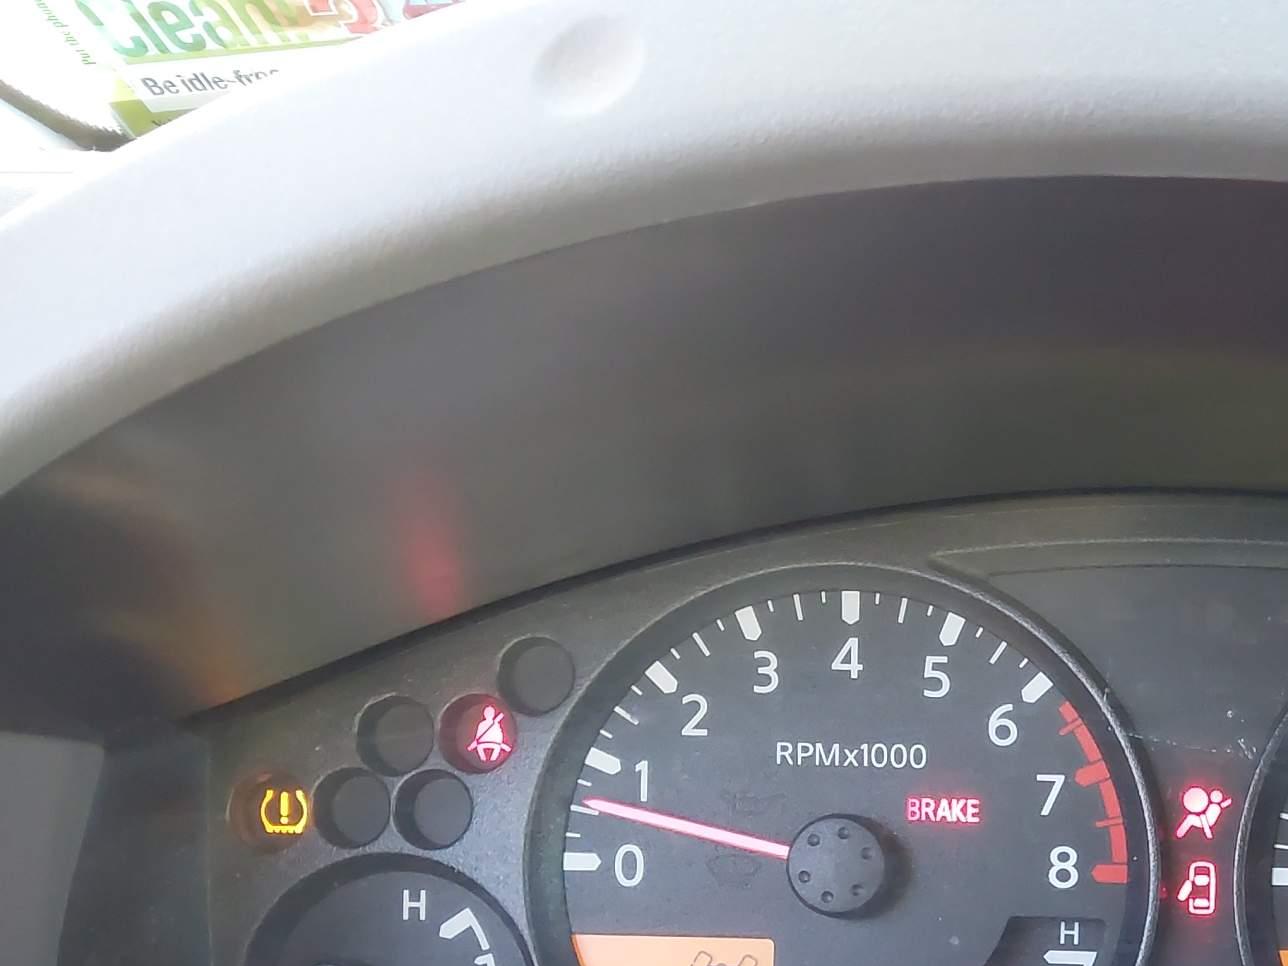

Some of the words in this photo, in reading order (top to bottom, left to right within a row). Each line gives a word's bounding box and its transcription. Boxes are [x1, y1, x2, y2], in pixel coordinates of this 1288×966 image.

[140, 76, 180, 96] Be
[753, 650, 779, 694] 3
[831, 637, 864, 679] 4
[923, 655, 951, 698] 5
[681, 693, 708, 736] 2
[988, 703, 1018, 747] 6
[776, 741, 927, 769] RPMx1000
[635, 760, 649, 802] 1
[1036, 774, 1066, 816] 7
[906, 797, 981, 824] BRAKE
[614, 843, 645, 887] 0
[1048, 845, 1079, 889] 8
[402, 889, 427, 921] H
[1059, 921, 1079, 945] H
